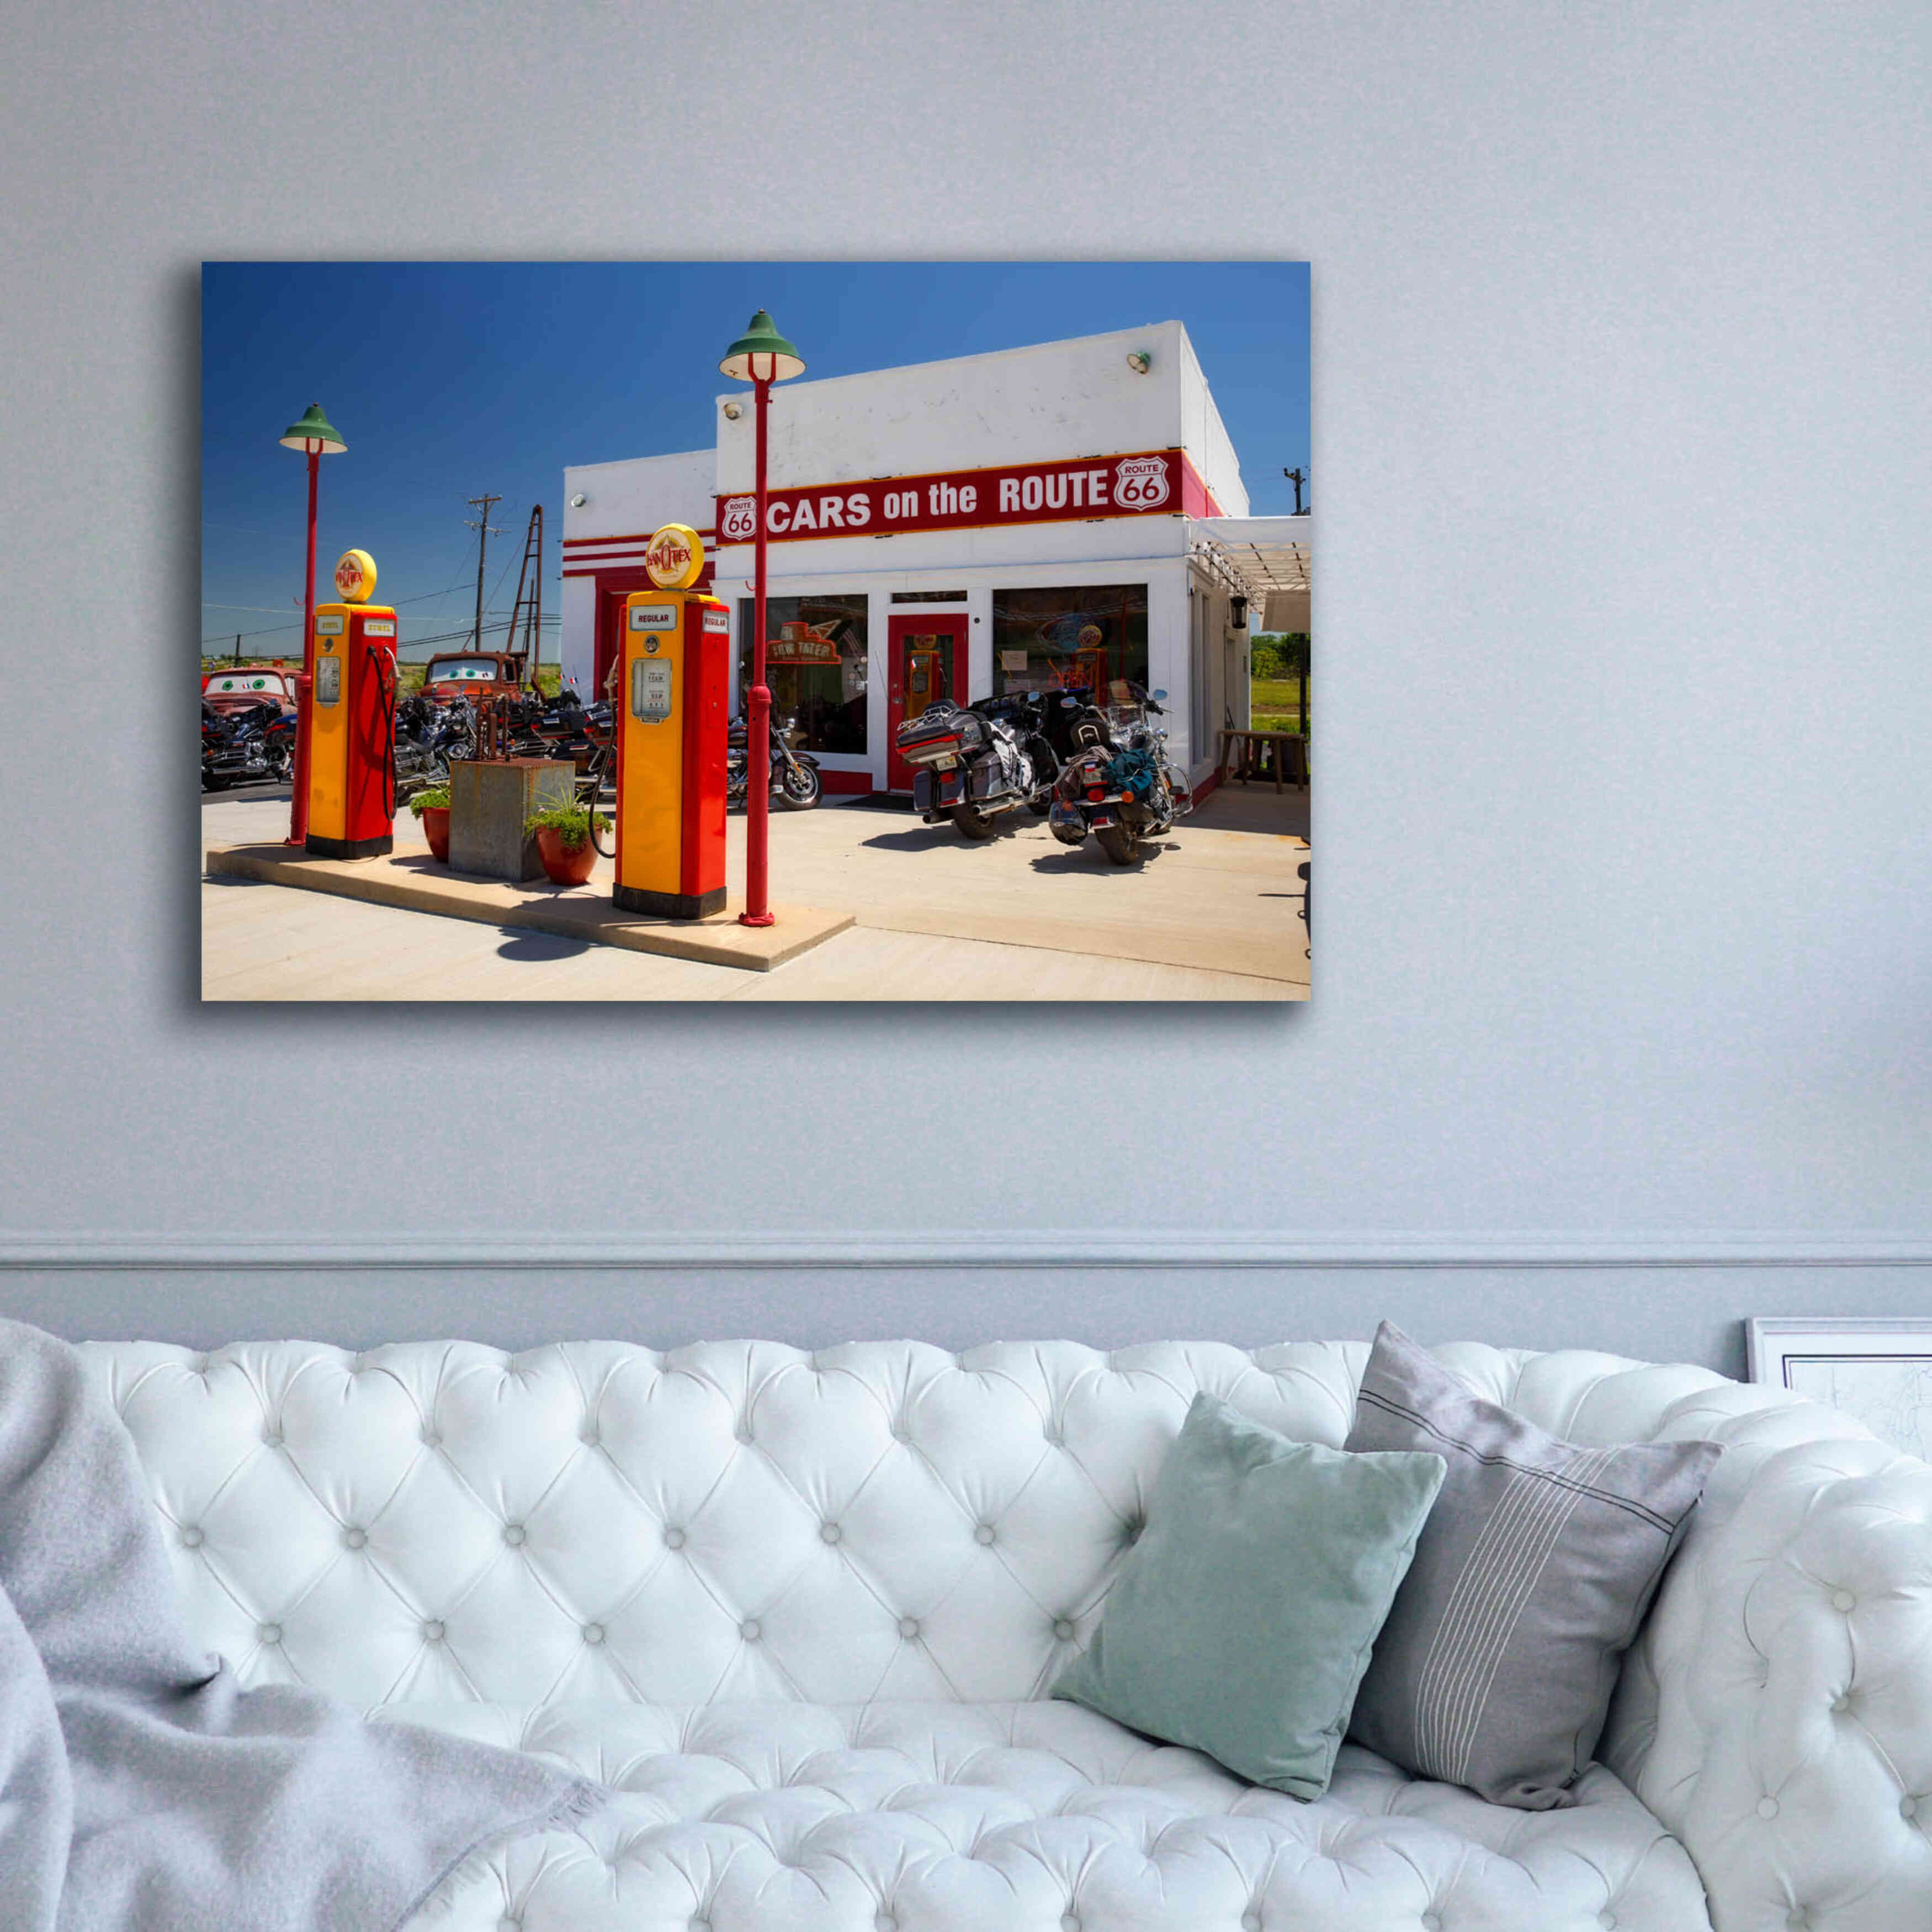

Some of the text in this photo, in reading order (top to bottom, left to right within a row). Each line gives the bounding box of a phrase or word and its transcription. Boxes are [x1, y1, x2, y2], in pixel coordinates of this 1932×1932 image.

[1125, 464, 1159, 474] ROUTE
[1123, 476, 1160, 502] 66
[730, 501, 752, 511] ROUTE
[766, 469, 1109, 533] CARS on the ROUTE
[728, 512, 752, 533] 66
[638, 614, 669, 623] REGULAR
[704, 617, 726, 627] REGULAR
